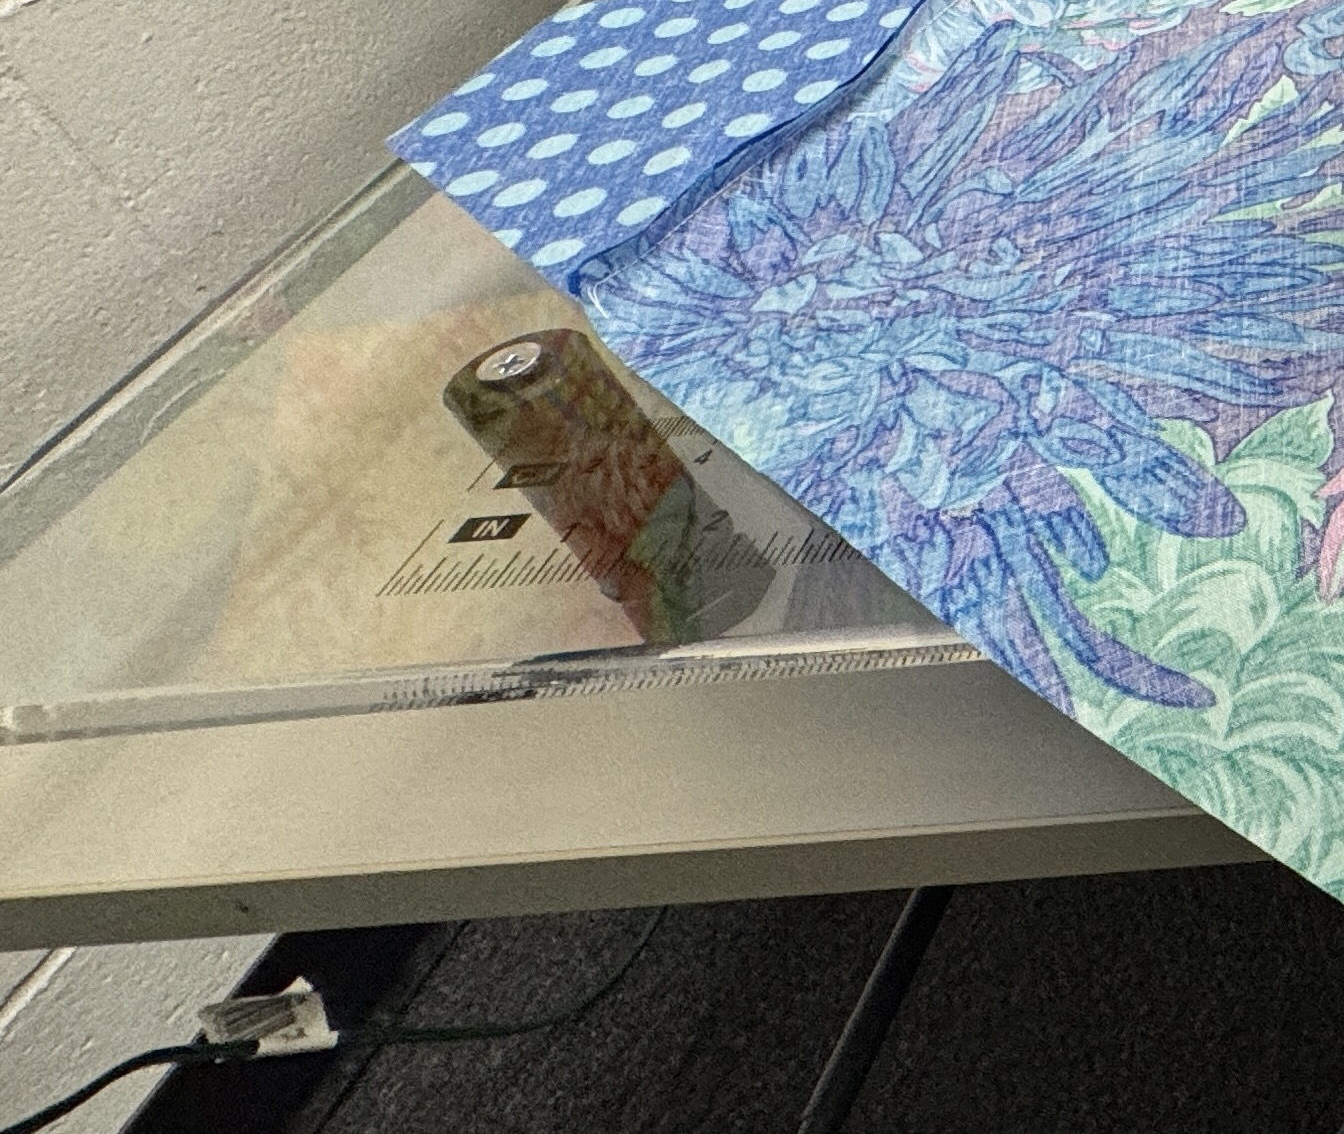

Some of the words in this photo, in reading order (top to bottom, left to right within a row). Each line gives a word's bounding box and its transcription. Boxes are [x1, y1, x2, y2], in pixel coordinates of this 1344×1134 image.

[471, 517, 512, 538] IN
[559, 521, 582, 544] 1
[702, 509, 730, 533] 2
